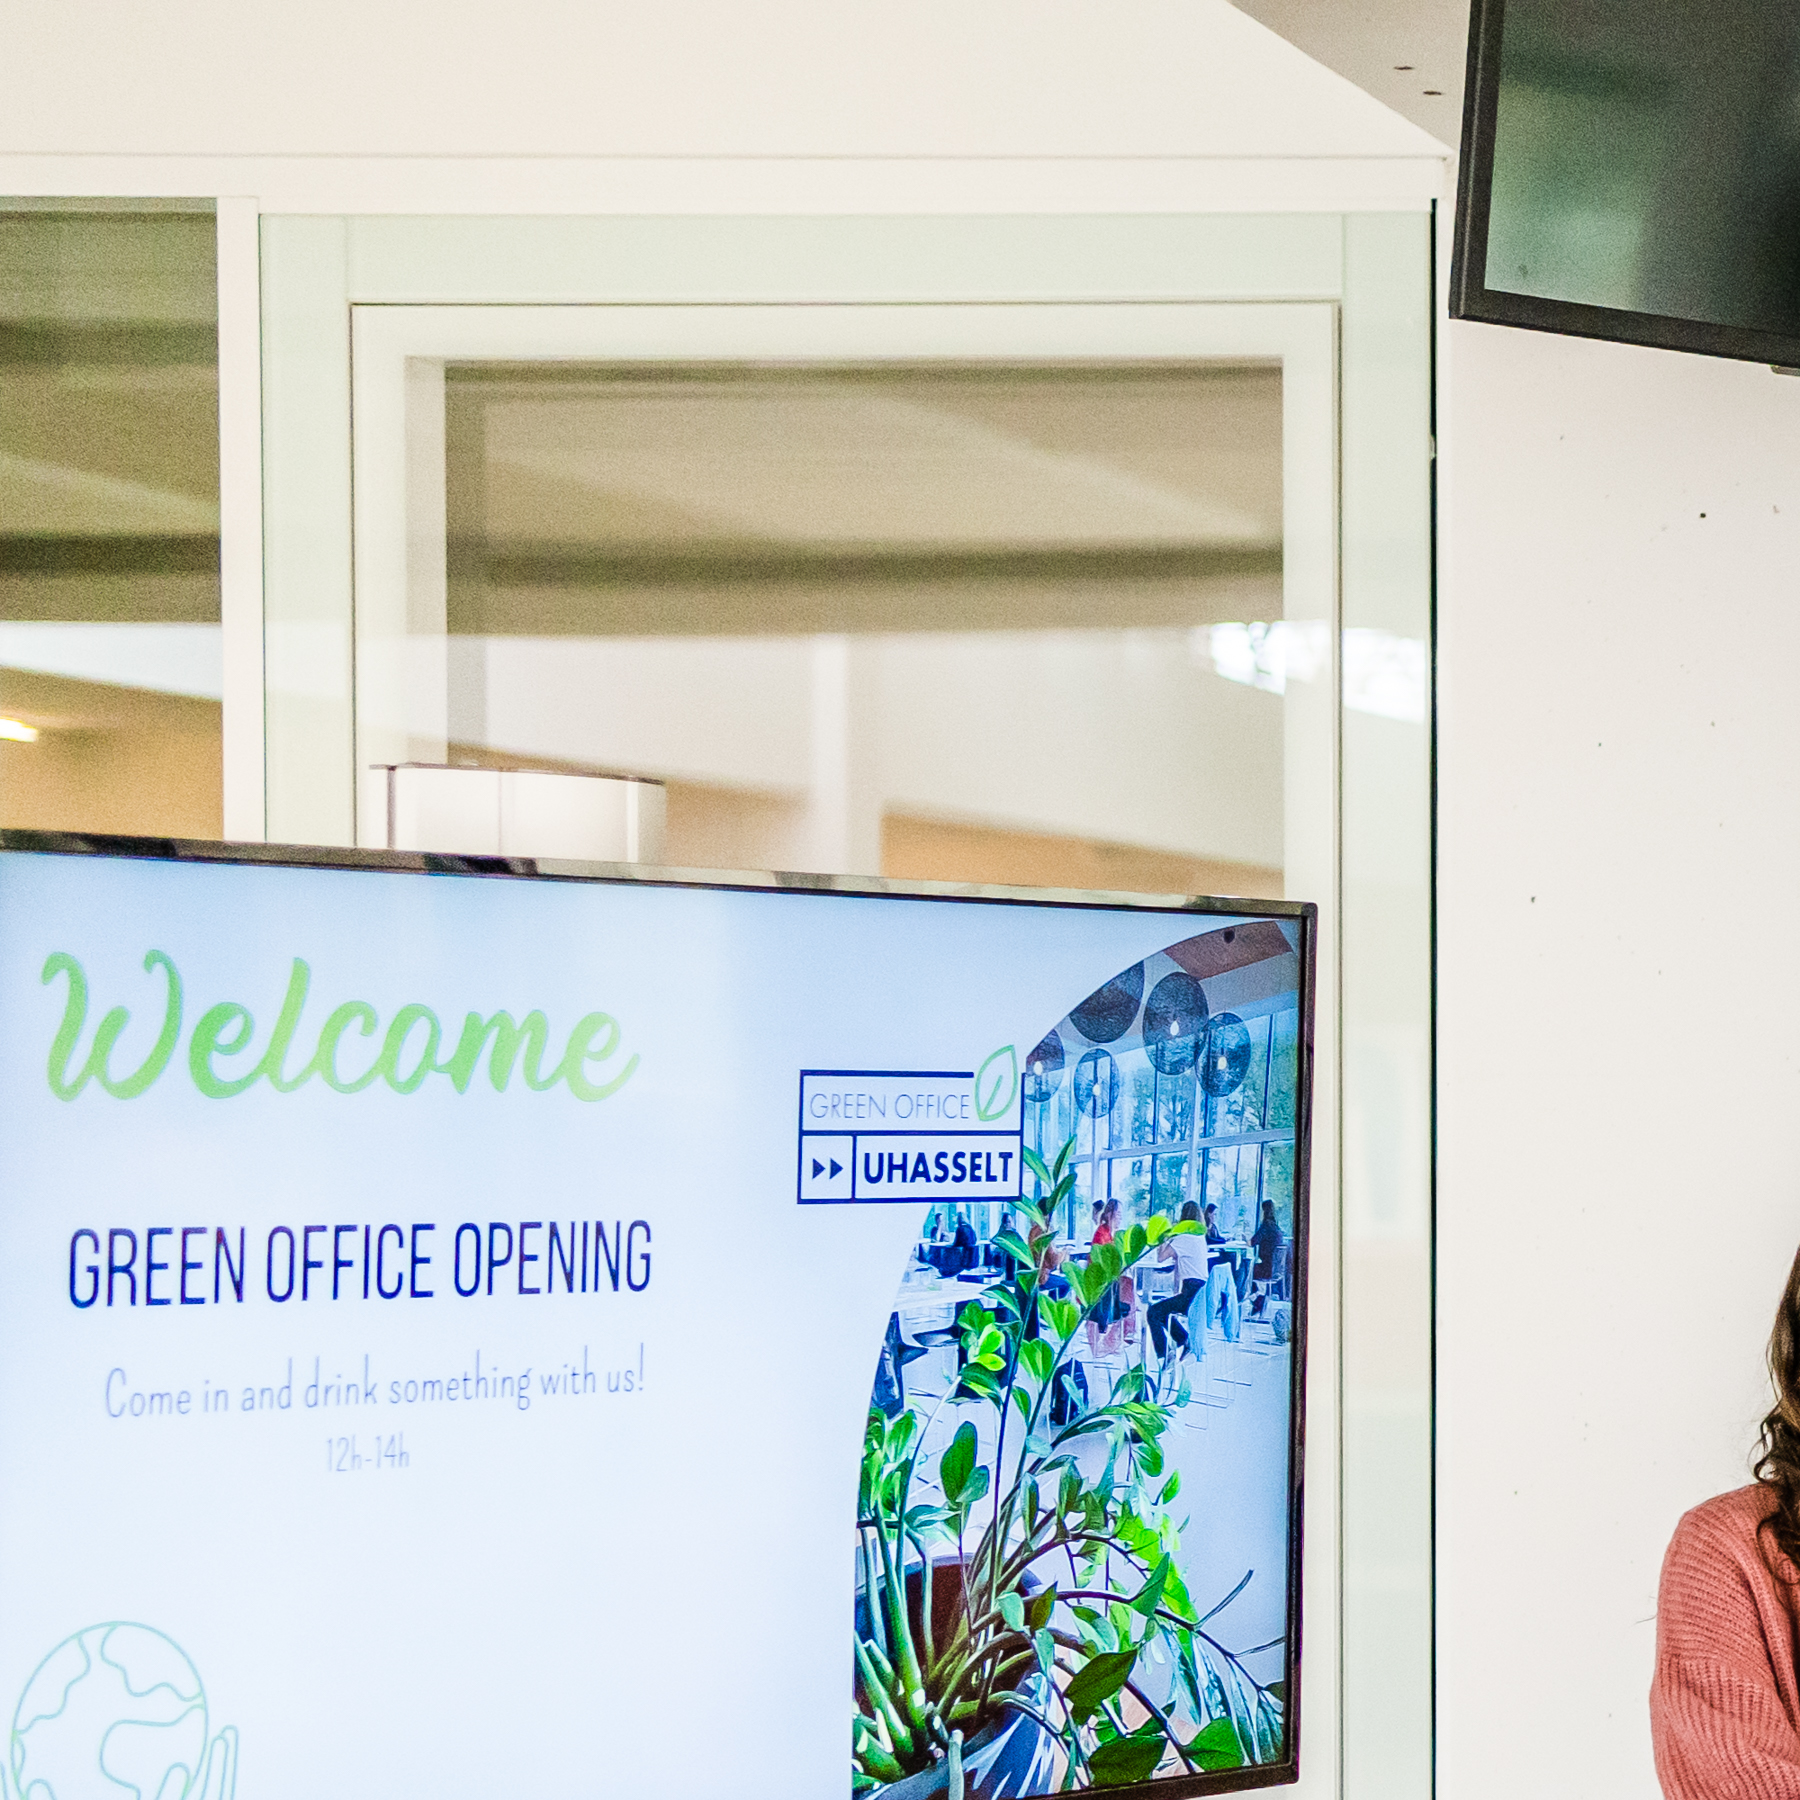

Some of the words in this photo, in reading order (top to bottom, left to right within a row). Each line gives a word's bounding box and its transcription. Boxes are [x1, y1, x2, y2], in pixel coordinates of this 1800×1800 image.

[40, 948, 640, 1104] Welcome
[809, 1093, 887, 1118] GREEN
[895, 1094, 970, 1119] OFFICE
[864, 1152, 1012, 1183] UHASSELT
[66, 1228, 249, 1308] GREEN
[265, 1224, 433, 1302] OFFICE
[453, 1220, 654, 1297] OPENING
[105, 1368, 192, 1418] Come
[203, 1380, 228, 1412] in
[241, 1358, 292, 1411] and
[304, 1354, 378, 1408] drink
[389, 1349, 531, 1411] something
[539, 1345, 596, 1396] with
[607, 1343, 645, 1393] us!
[325, 1432, 410, 1472] 12h-14h
